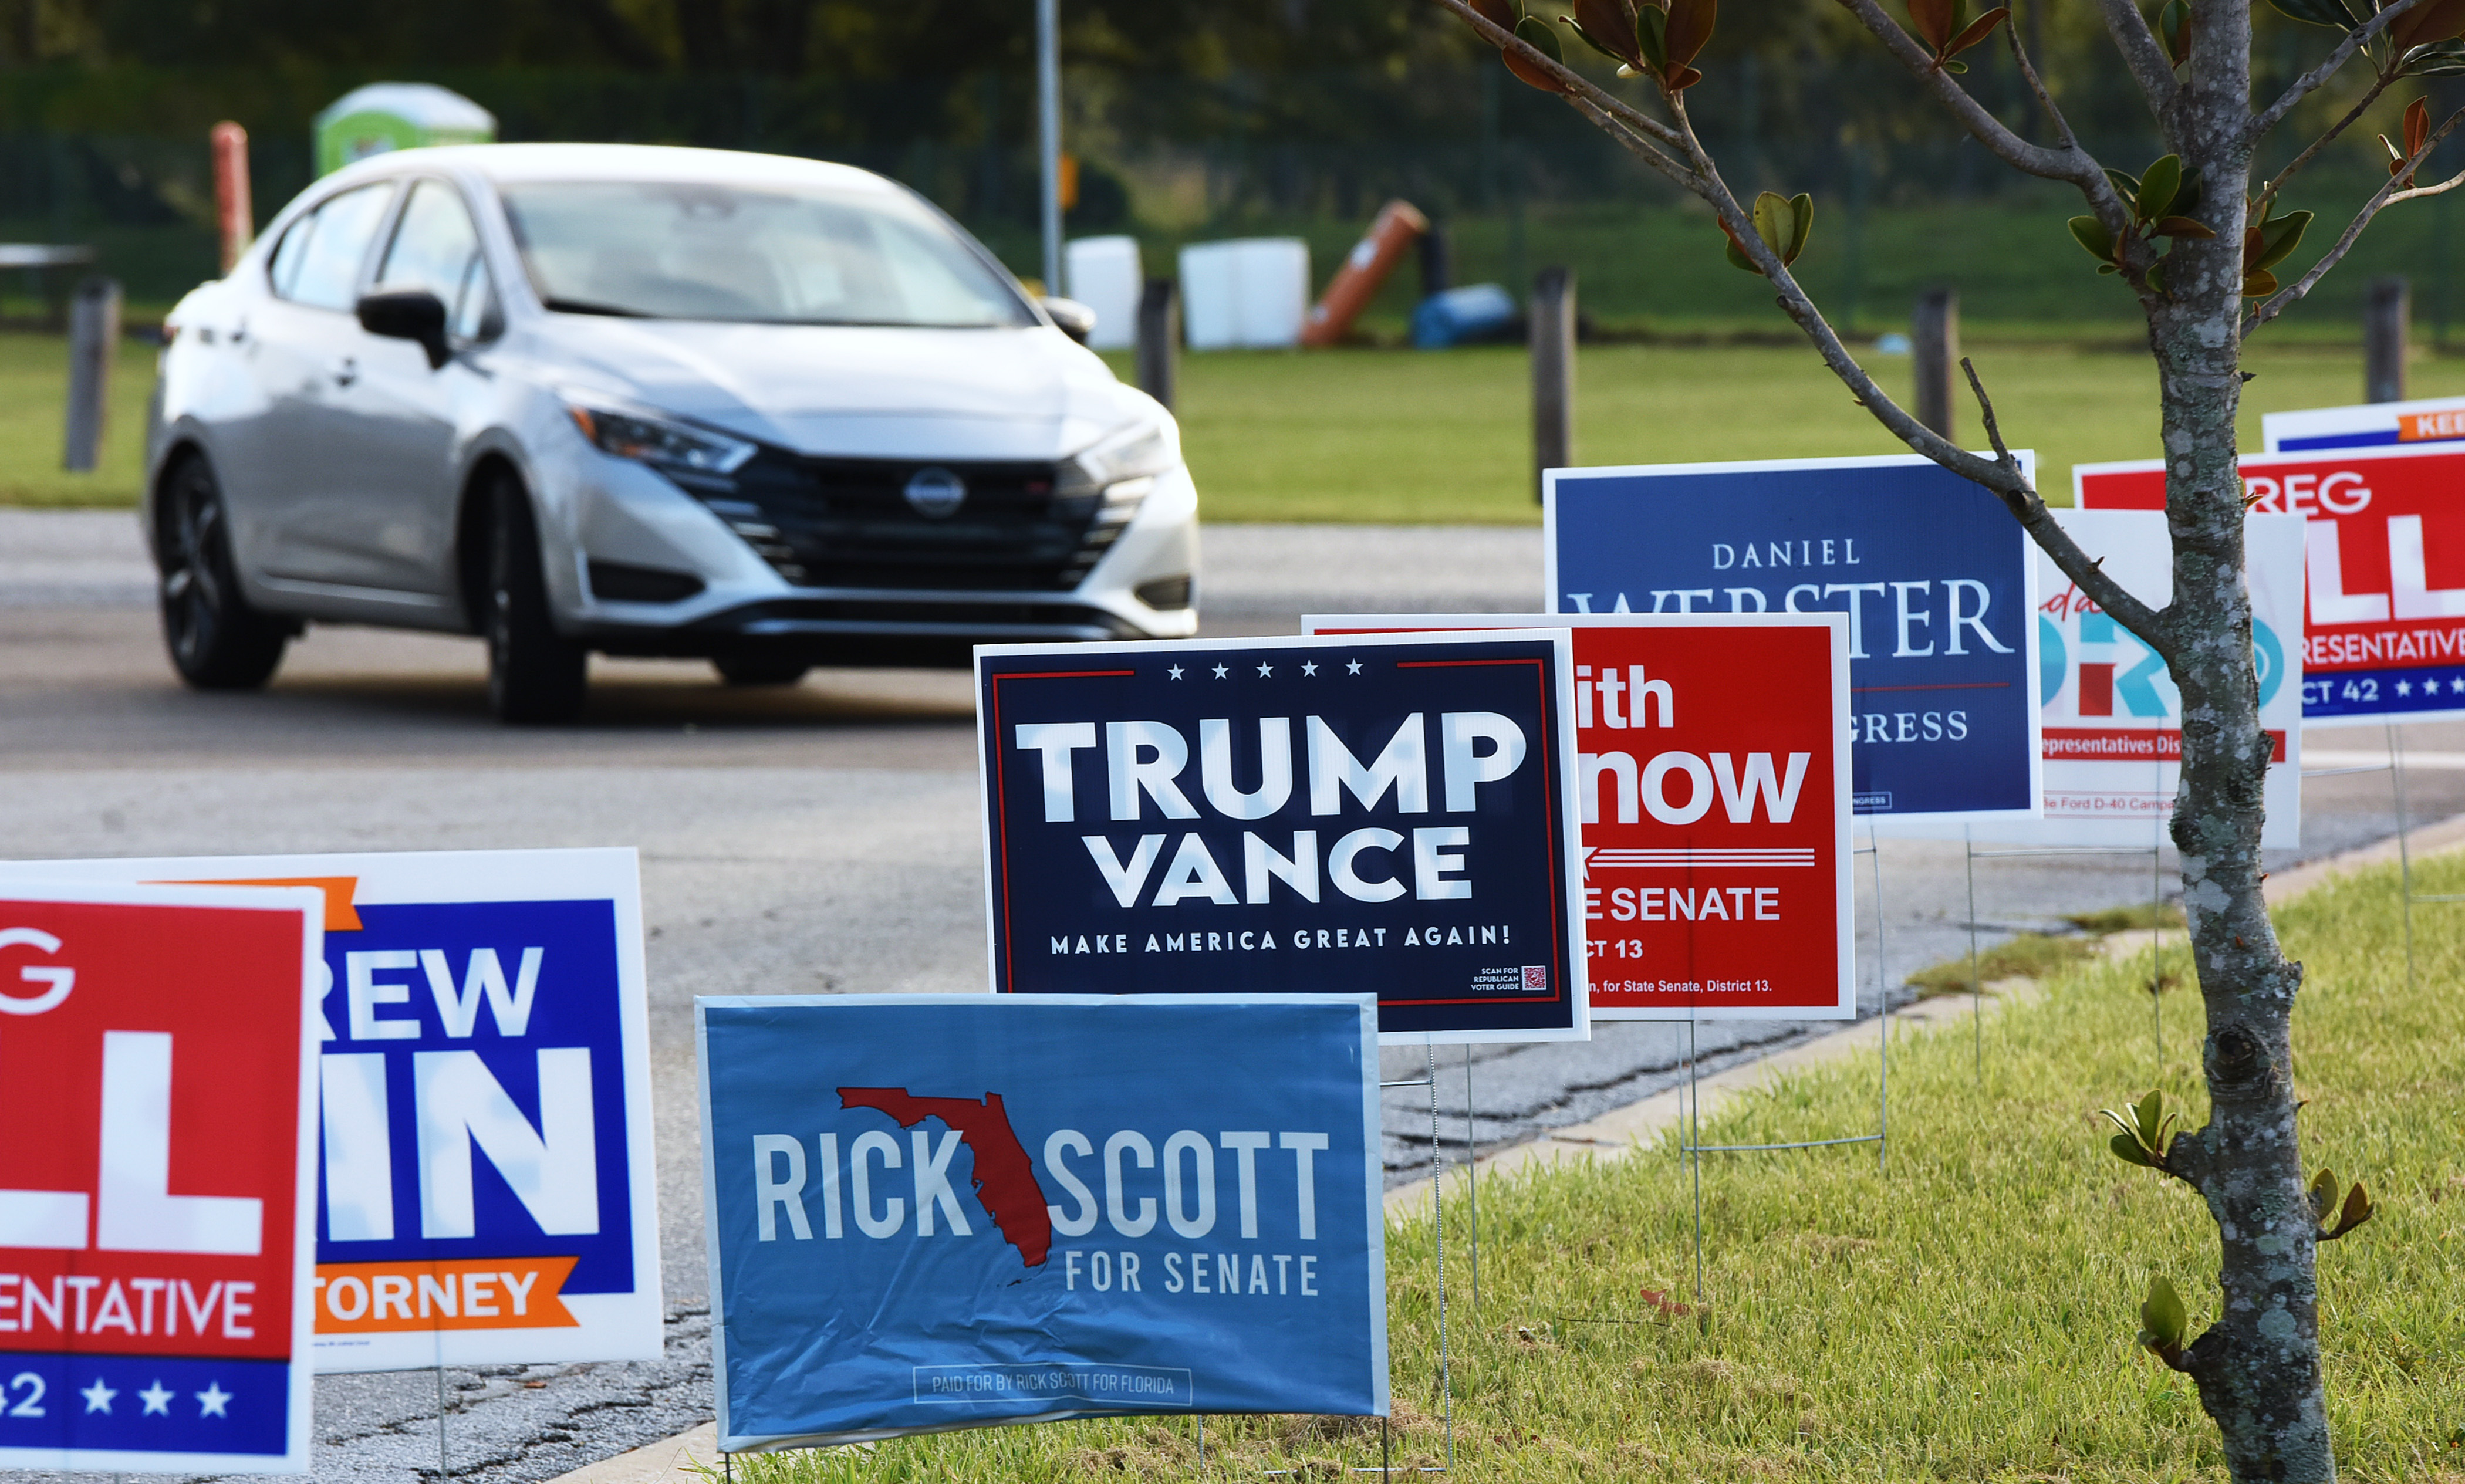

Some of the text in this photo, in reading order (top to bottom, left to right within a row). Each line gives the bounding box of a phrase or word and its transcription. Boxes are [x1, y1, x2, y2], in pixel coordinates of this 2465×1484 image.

[2245, 471, 2372, 515] REG
[1712, 538, 1860, 570] DANIEL
[1576, 665, 1674, 729] ith
[2302, 678, 2379, 705] CT 42
[1015, 712, 1526, 822] TRUMP
[1578, 751, 1811, 825] now
[2061, 797, 2091, 809] Ford
[1082, 826, 1473, 908] VANCE
[1610, 887, 1781, 921] SENATE
[1051, 925, 1510, 954] MAKE AMERICA GREAT AGAIN!
[1615, 939, 1643, 958] 13
[1603, 981, 1620, 992] for
[1624, 981, 1654, 992] State
[1658, 981, 1704, 993] Senate,
[1707, 980, 1751, 992] District
[1755, 979, 1772, 991] 13.
[0, 1030, 263, 1256] L
[753, 1129, 1329, 1242] RICK SCOTT
[1065, 1251, 1318, 1296] FOR SENATE
[0, 1371, 46, 1418] 2
[933, 1372, 1174, 1394] PAID FOR BY RICK SCOTT FOR FLORIDA
